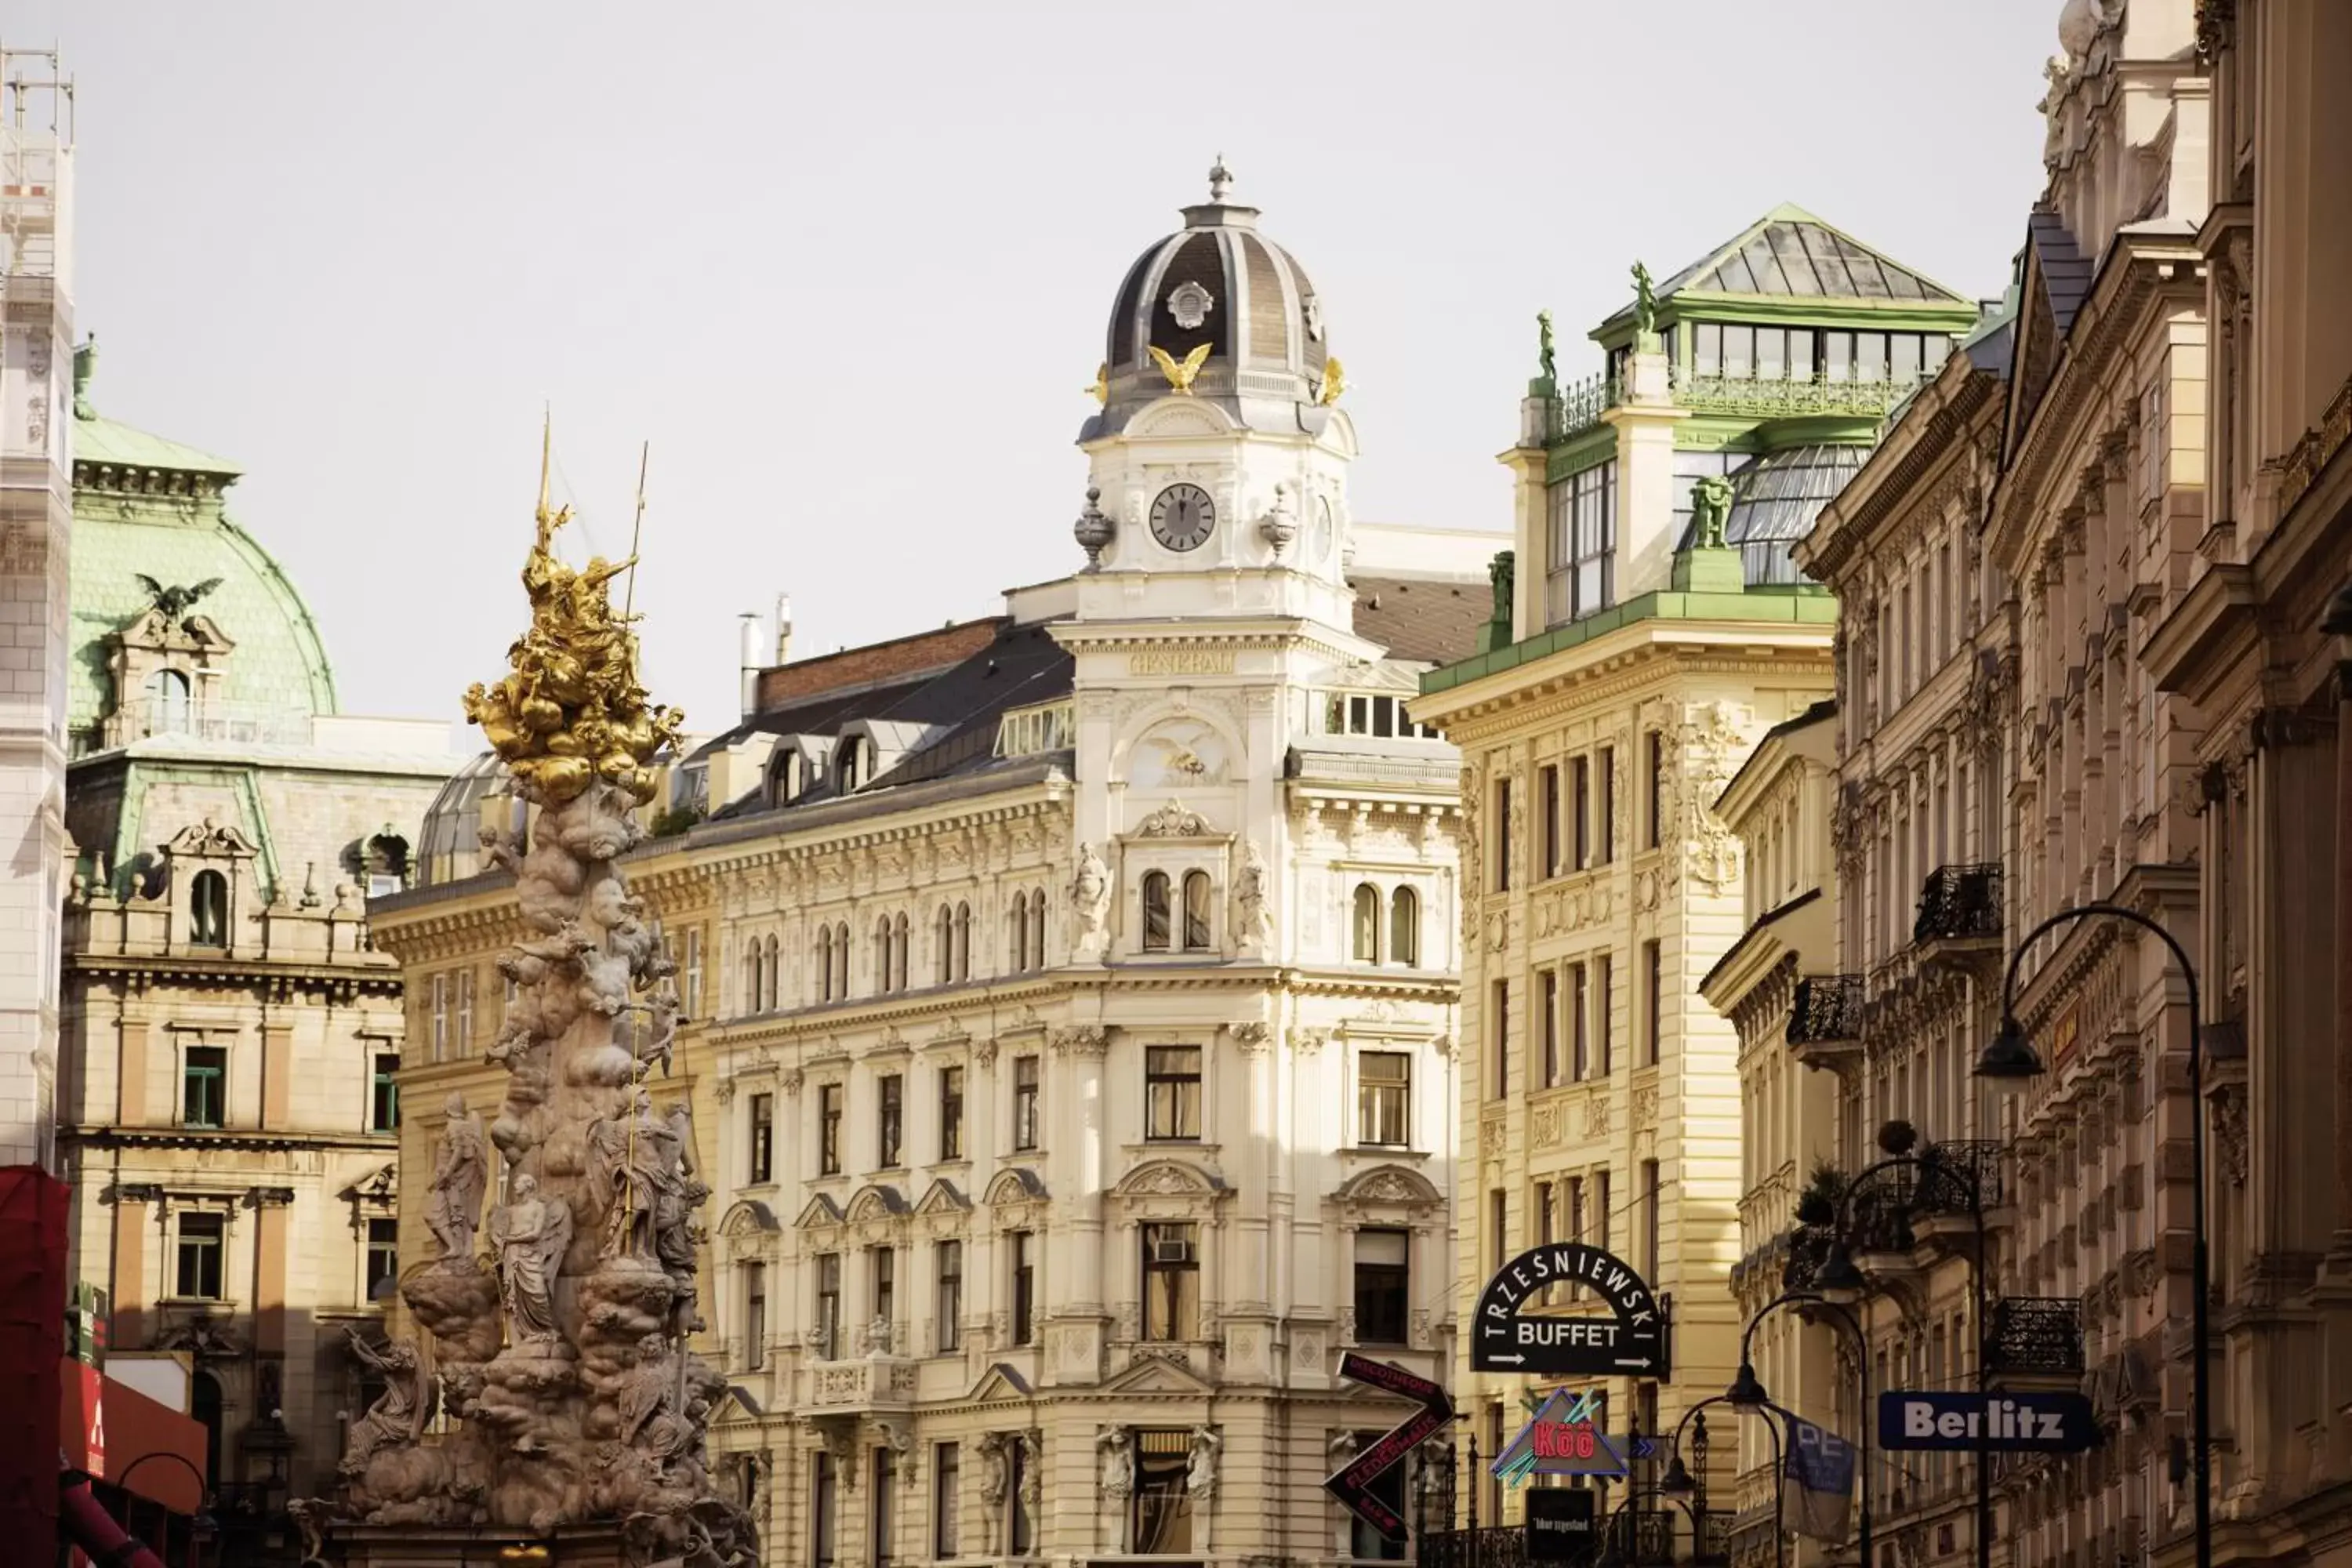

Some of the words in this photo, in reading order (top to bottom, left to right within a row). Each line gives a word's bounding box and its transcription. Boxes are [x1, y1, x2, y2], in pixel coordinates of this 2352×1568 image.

[1517, 1323, 1621, 1347] BUFFET
[1904, 1399, 2064, 1439] Berlitz
[1534, 1421, 1595, 1458] Köö
